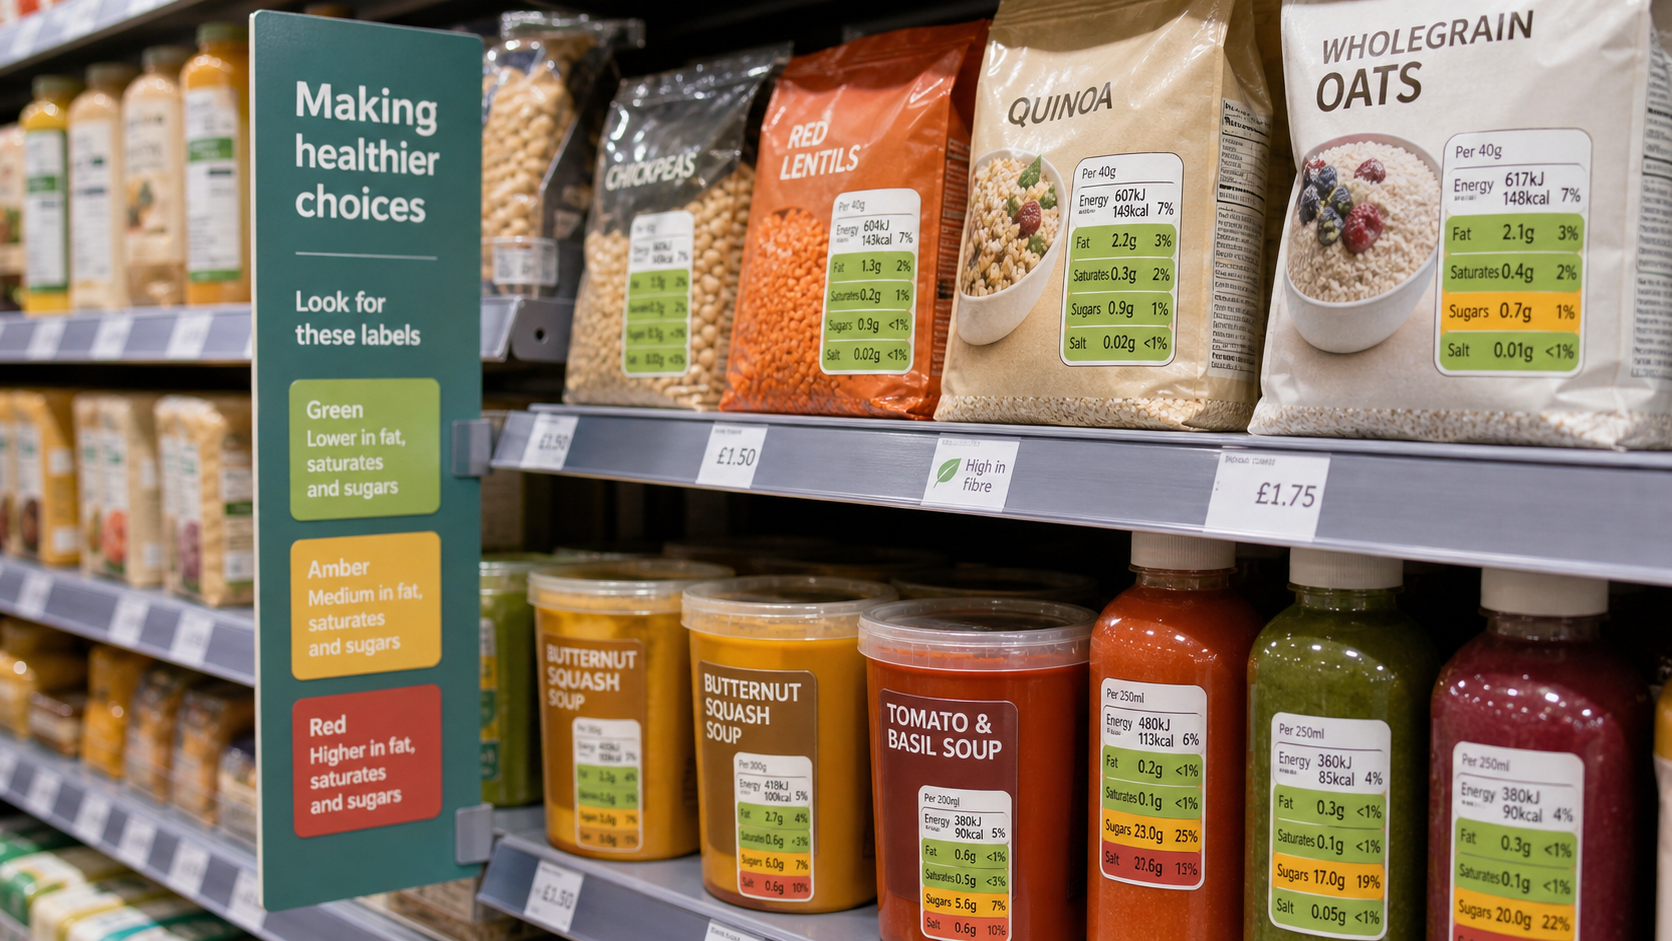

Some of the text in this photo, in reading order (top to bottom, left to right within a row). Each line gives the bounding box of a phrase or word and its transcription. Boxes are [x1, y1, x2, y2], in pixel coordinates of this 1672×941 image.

[1323, 10, 1534, 64] WHOLEGRAIN
[1316, 62, 1422, 112] OATS
[296, 80, 437, 136] Making
[1008, 82, 1112, 128] QUINOA
[788, 121, 828, 149] RED
[295, 133, 440, 175] healthier
[1455, 144, 1502, 159] Per 40g
[605, 152, 697, 191] CHICKPEAS
[780, 145, 860, 180] LENTILS
[1082, 166, 1116, 180] Per 40g
[1454, 172, 1544, 194] Energy 617kJ
[295, 184, 426, 223] choices
[1079, 189, 1146, 208] Energy 607kJ
[1503, 188, 1581, 206] 148kcal 7%
[1157, 202, 1174, 216] 7%
[899, 232, 913, 244] 7%
[1076, 233, 1172, 250] Fat 2.2g 3%
[1453, 224, 1578, 243] Fat 2.1g 3%
[862, 260, 911, 274] 1.3g 2%
[1074, 266, 1170, 284] Saturates 0.3g 2%
[1451, 264, 1577, 282] Saturates 0.4g 2%
[296, 290, 386, 313] Look for
[860, 289, 910, 303] 0.2g 1%
[1071, 300, 1168, 318] Sugars 0.9g 1%
[1449, 303, 1575, 321] Sugars 0.7g 1%
[295, 323, 421, 345] these labels
[858, 318, 879, 333] 0.9g
[1069, 335, 1167, 352] Salt 0.02g <1%
[1448, 341, 1574, 361] Salt 0.01g <1%
[854, 348, 880, 363] 0.02g
[306, 401, 363, 419] Green
[307, 428, 406, 447] Lower in fat,
[307, 454, 383, 473] saturates
[717, 447, 756, 466] £1.50
[966, 459, 1005, 476] High in
[307, 480, 398, 499] and sugars
[963, 477, 992, 493] fibre
[1255, 482, 1317, 507] £1.75
[308, 559, 370, 578] Amber
[309, 582, 422, 606] Medium in fat,
[309, 611, 385, 632] saturates
[309, 636, 400, 657] and sugars
[547, 644, 637, 669] BUTTERNUT
[548, 666, 620, 691] SQUASH
[704, 673, 801, 702] BUTTERNUT
[549, 689, 585, 711] SOUP
[1106, 688, 1144, 703] Per 250ml
[706, 698, 770, 725] SQUASH
[887, 703, 992, 733] TOMATO &
[310, 715, 346, 736] Red
[706, 721, 742, 744] SOUP
[1106, 714, 1132, 731] Energy
[1139, 717, 1170, 732] 480kJ
[1279, 723, 1324, 739] Per 250ml
[888, 729, 1002, 760] BASIL SOUP
[1138, 733, 1199, 747] 113kcal 6%
[311, 735, 415, 766] Higher in fat,
[1106, 755, 1198, 778] Fat 0.2g <1%
[1279, 751, 1352, 770] Energy 360kJ
[311, 766, 386, 790] saturates
[1319, 771, 1383, 786] 85kcal 4%
[311, 787, 402, 814] and sugars
[925, 793, 935, 803] Per
[1139, 791, 1198, 811] 0.1g <1%
[1461, 782, 1496, 803] Energy
[1502, 787, 1540, 804] 380kJ
[1279, 795, 1382, 820] Fat 0.3g <1%
[1503, 805, 1573, 822] 90kcal 4%
[765, 812, 783, 825] 2.7g
[925, 814, 982, 828] Energy 380kJ
[955, 828, 1005, 840] 90kcal 5%
[1106, 818, 1198, 844] Sugars 23.0g 25%
[766, 834, 784, 848] 0.6g
[1317, 834, 1381, 856] 0.1g <1%
[1461, 829, 1531, 857] Fat 0.3g
[766, 858, 784, 871] 6.0g
[925, 846, 1006, 864] Fat 0.6g <1%
[955, 873, 976, 888] 0.5g
[1277, 863, 1380, 890] Sugars 17.0g 19%
[1501, 871, 1530, 894] 0.1g
[926, 894, 1006, 912] Sugars 5.6g 7%
[1277, 898, 1380, 926] Salt 0.05g <1%
[1459, 899, 1570, 931] Sugars 20.0g 22%
[955, 922, 976, 936] 0.6g
